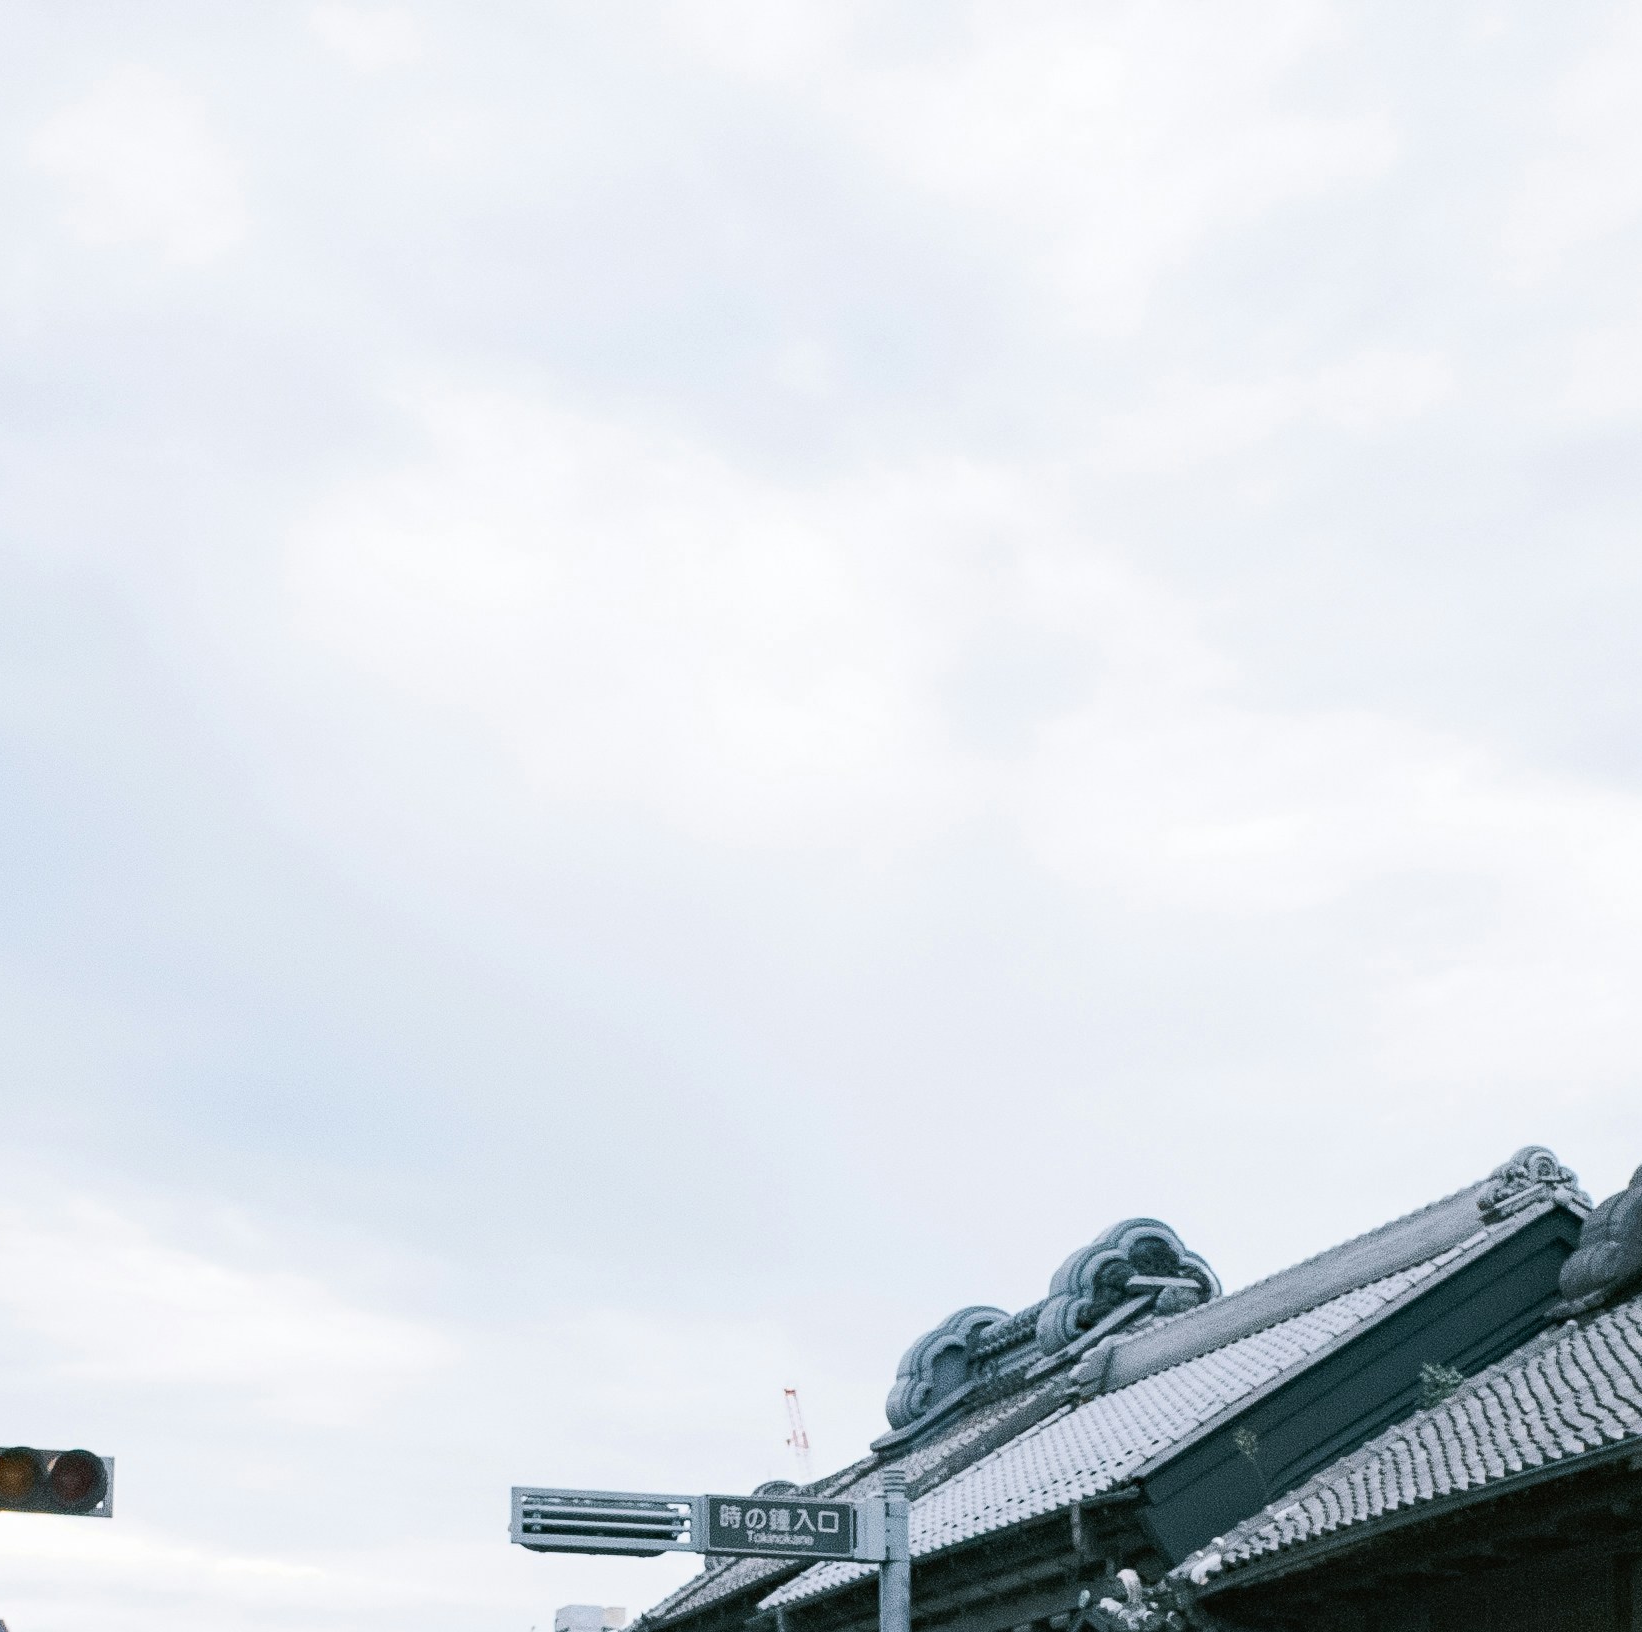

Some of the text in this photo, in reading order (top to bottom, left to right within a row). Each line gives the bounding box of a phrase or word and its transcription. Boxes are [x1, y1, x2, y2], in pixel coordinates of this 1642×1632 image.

[719, 1504, 840, 1534] 時の鐘入口
